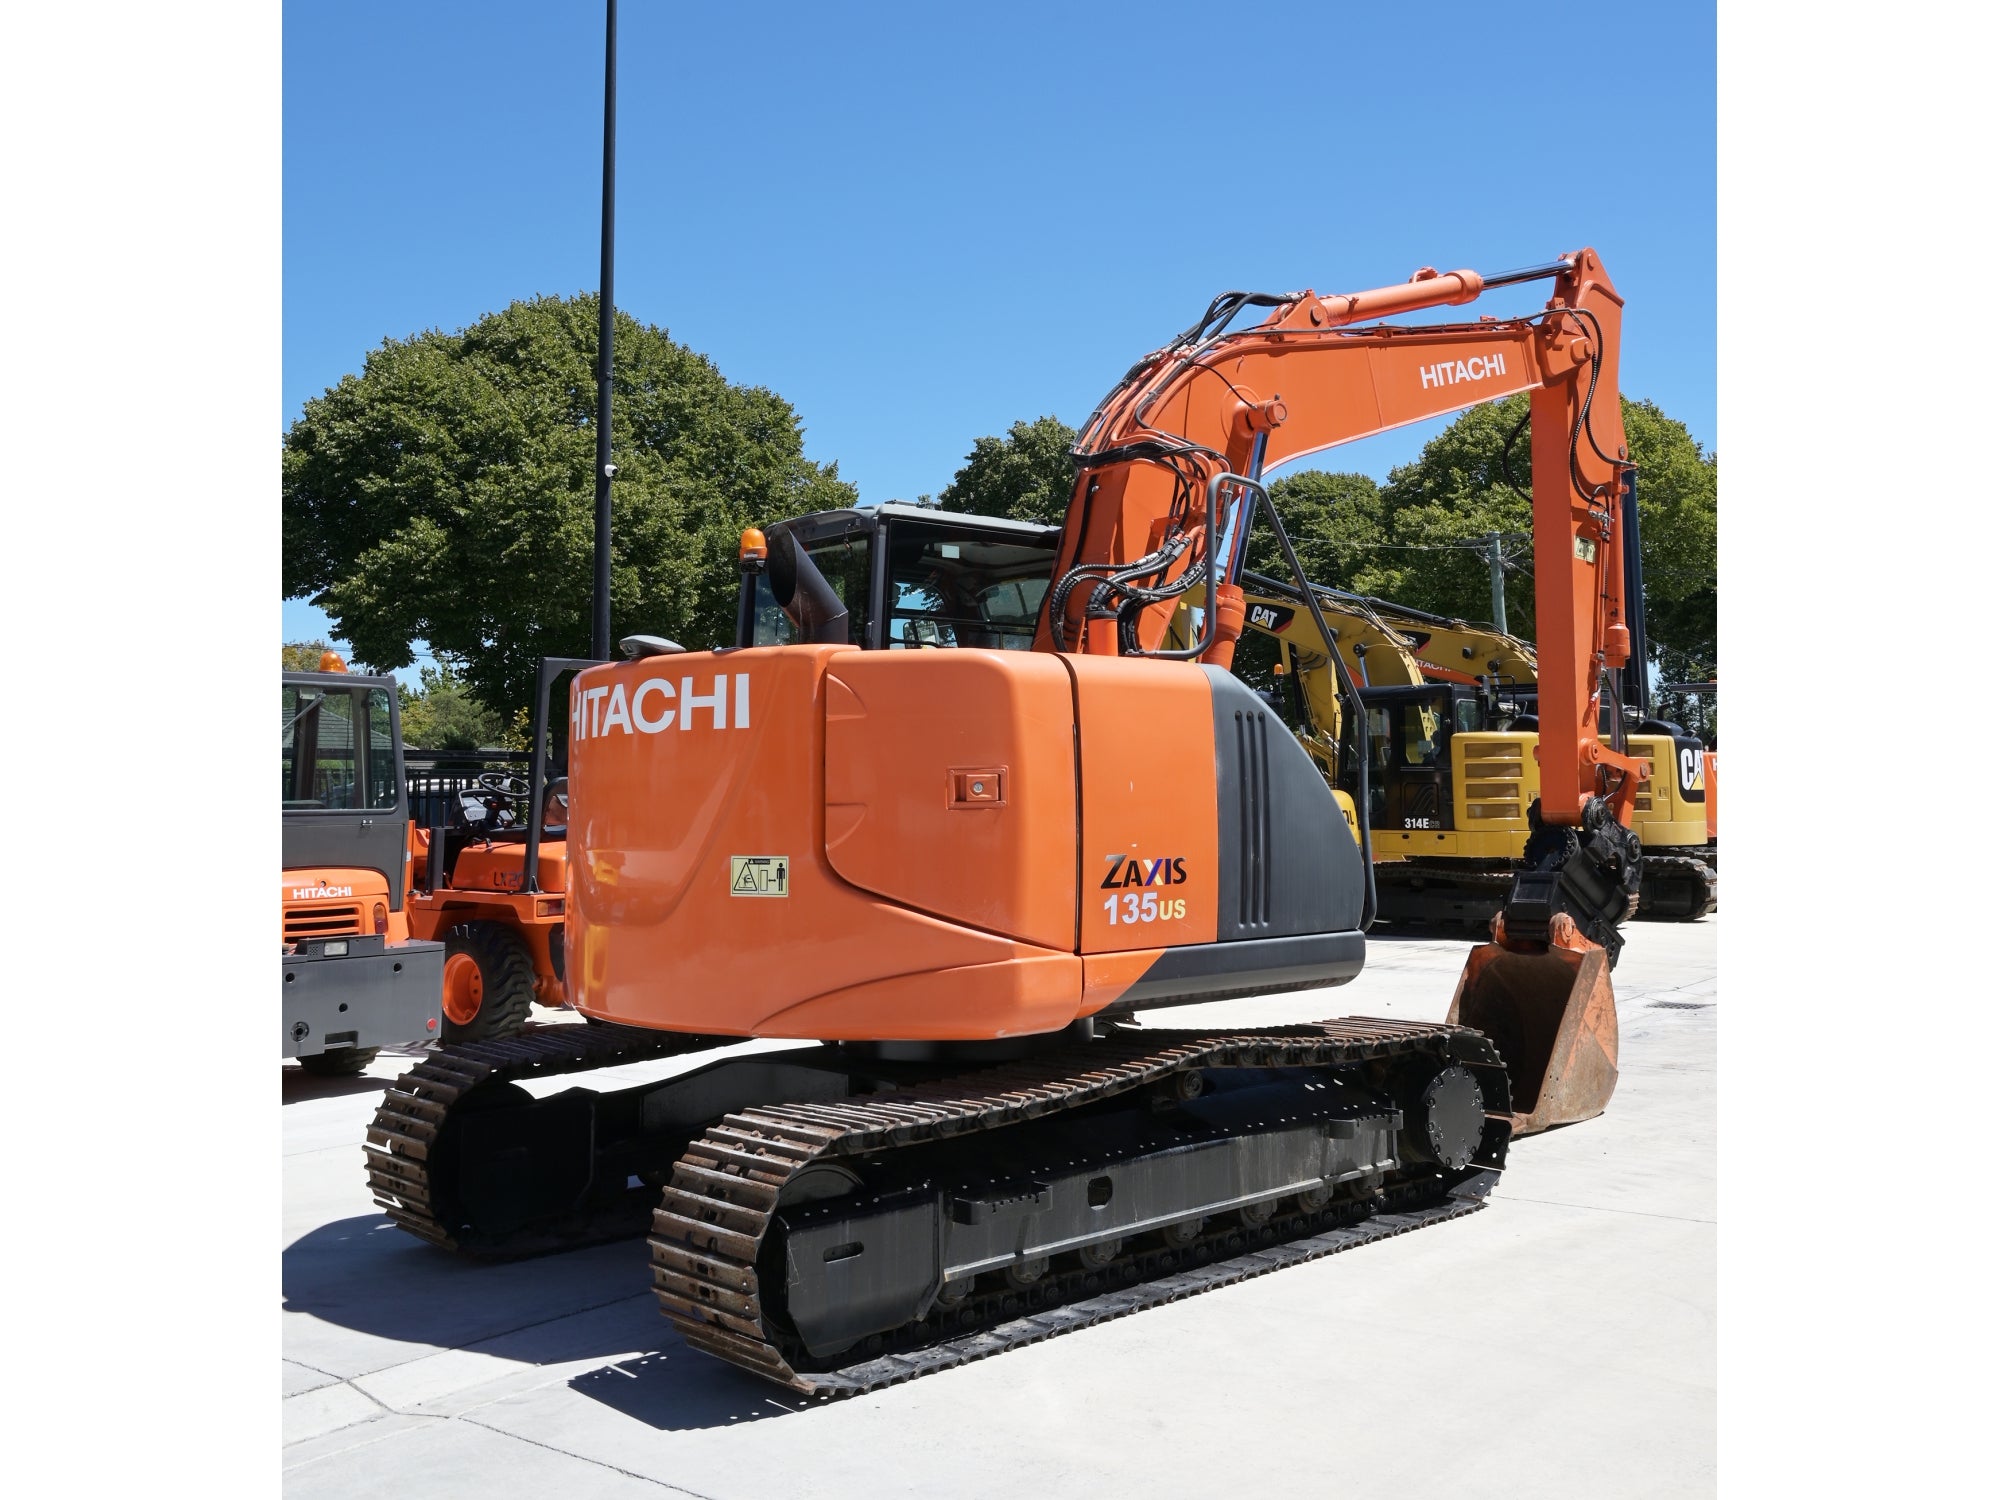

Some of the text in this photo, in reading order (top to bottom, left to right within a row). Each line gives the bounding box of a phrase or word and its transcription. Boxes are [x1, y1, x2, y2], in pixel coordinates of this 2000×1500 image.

[1420, 353, 1506, 389] HITACHI
[1251, 605, 1278, 629] CAT
[572, 673, 750, 742] HITACHI
[1681, 748, 1704, 791] CA
[1100, 854, 1187, 889] ZAXIS
[292, 886, 353, 900] HITACHI
